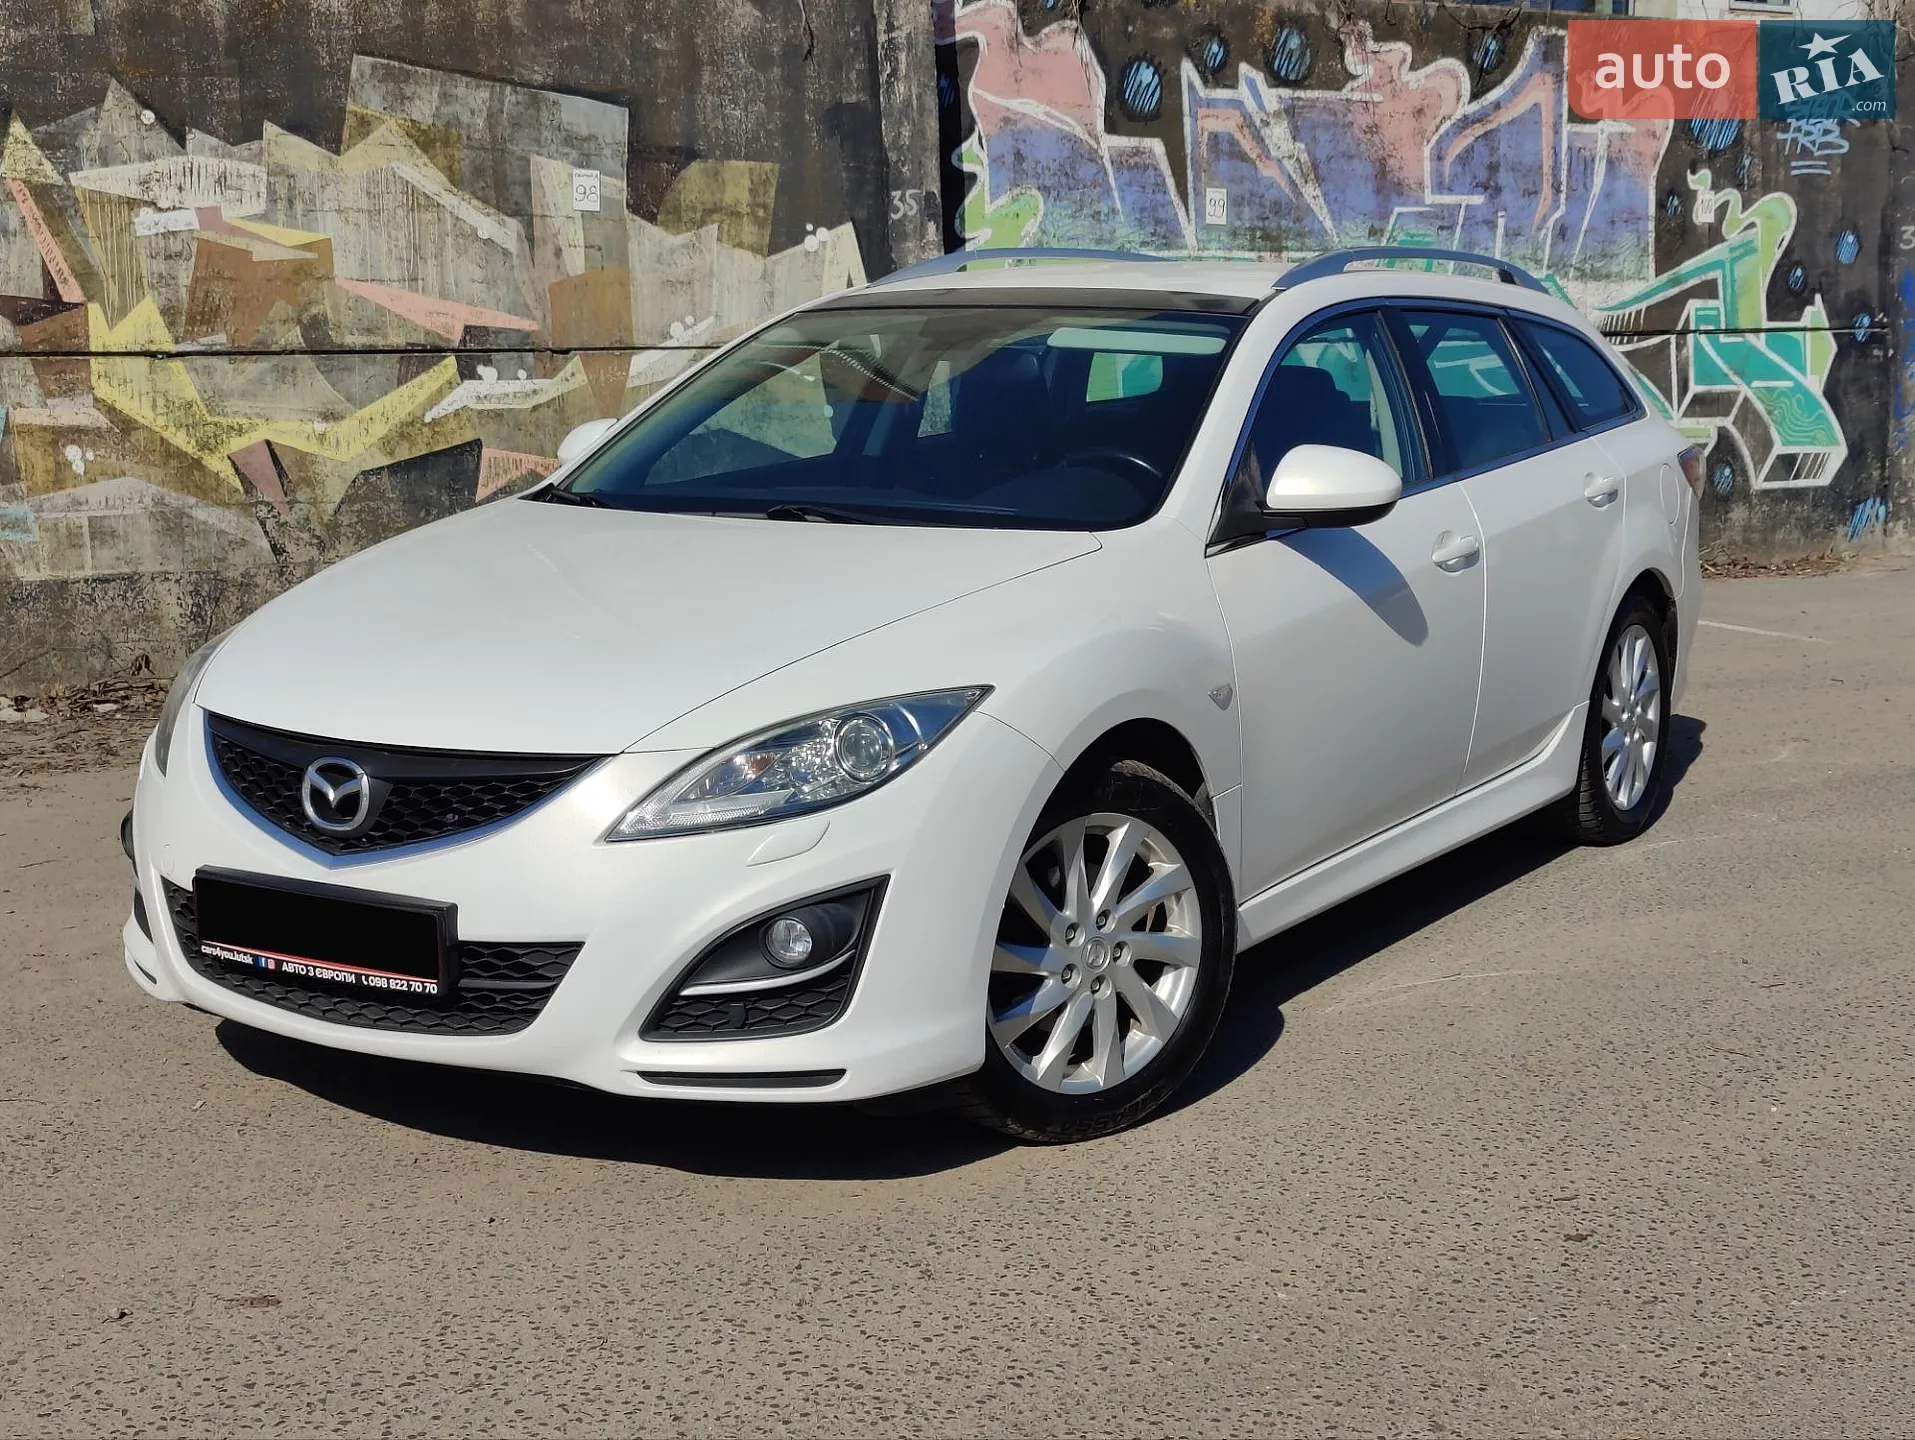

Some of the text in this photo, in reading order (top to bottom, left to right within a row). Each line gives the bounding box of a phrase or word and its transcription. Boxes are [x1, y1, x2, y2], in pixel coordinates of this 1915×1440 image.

[574, 184, 599, 203] 98
[890, 188, 922, 220] 35
[1207, 198, 1226, 219] 99
[281, 961, 307, 975] АВТО
[315, 967, 356, 984] ЄВРОПИ
[368, 976, 388, 988] 098
[389, 979, 408, 991] 822
[409, 981, 423, 993] 70
[423, 983, 438, 994] 70
